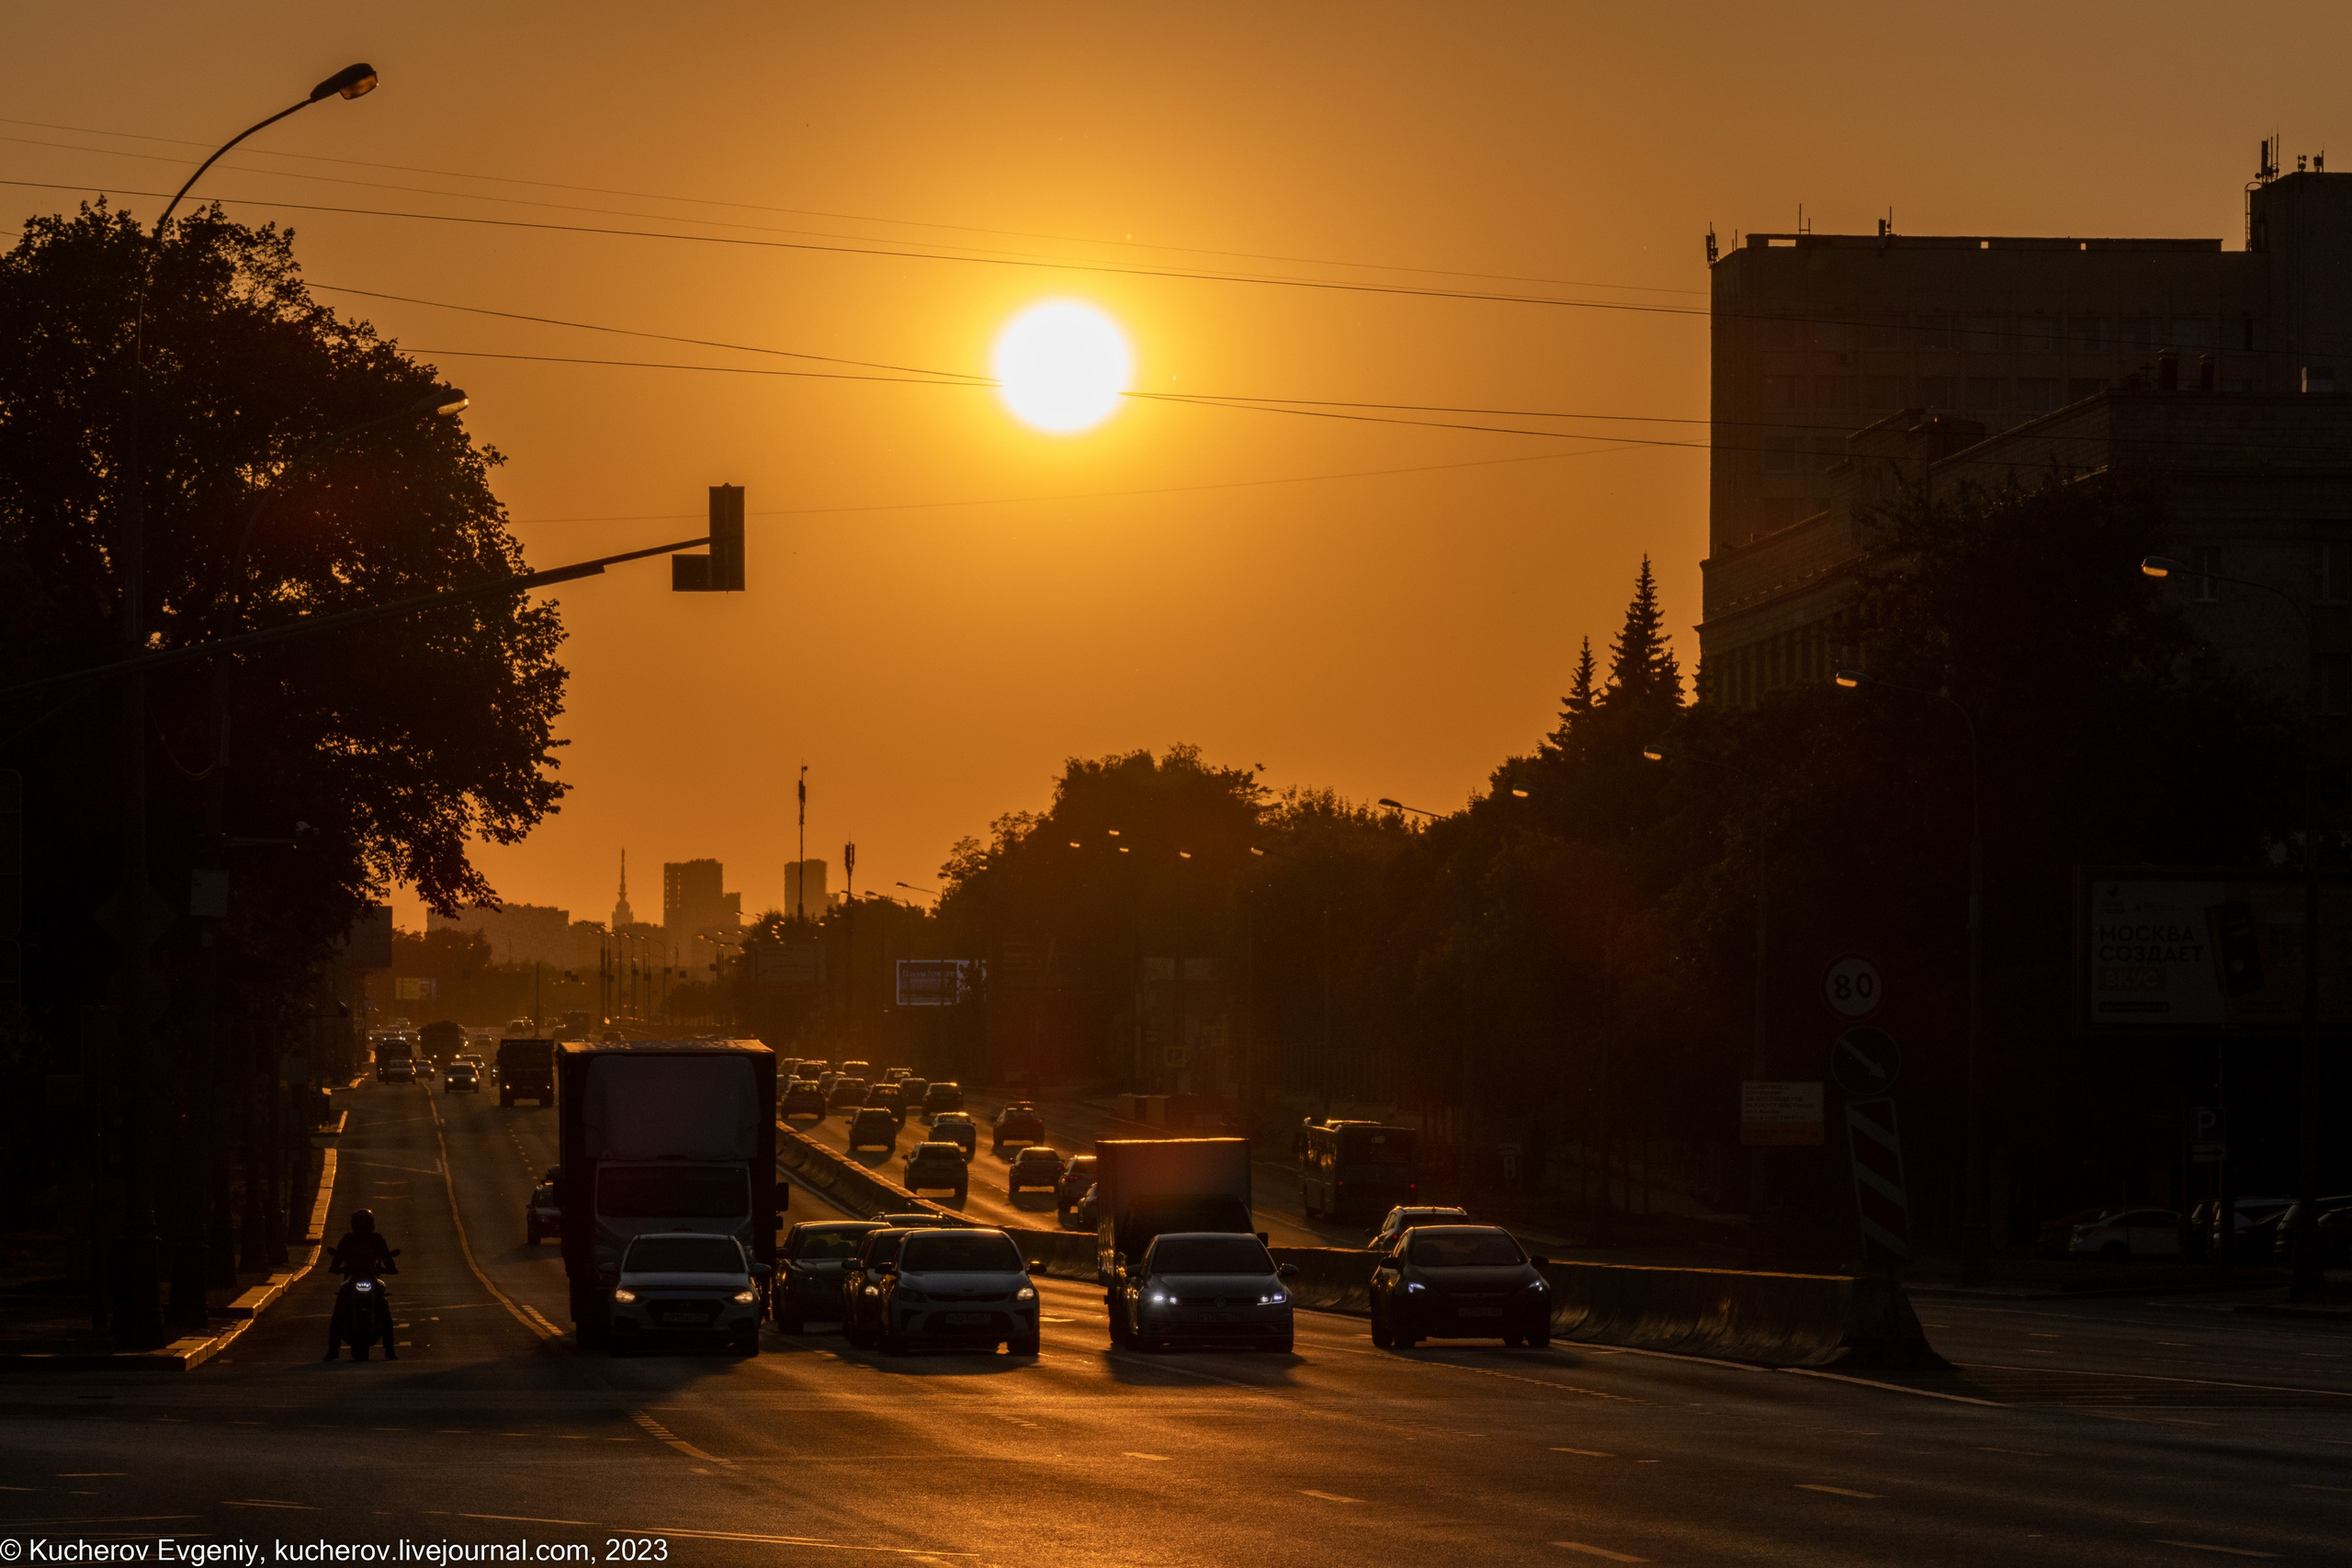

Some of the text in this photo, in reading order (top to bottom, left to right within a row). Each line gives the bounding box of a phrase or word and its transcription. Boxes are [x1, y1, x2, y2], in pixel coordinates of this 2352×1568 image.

[2099, 925, 2195, 942] МОСКВА
[2099, 945, 2205, 965] СОЗДАЕТ
[1834, 973, 1873, 999] 80
[2105, 971, 2158, 987] ВКУС
